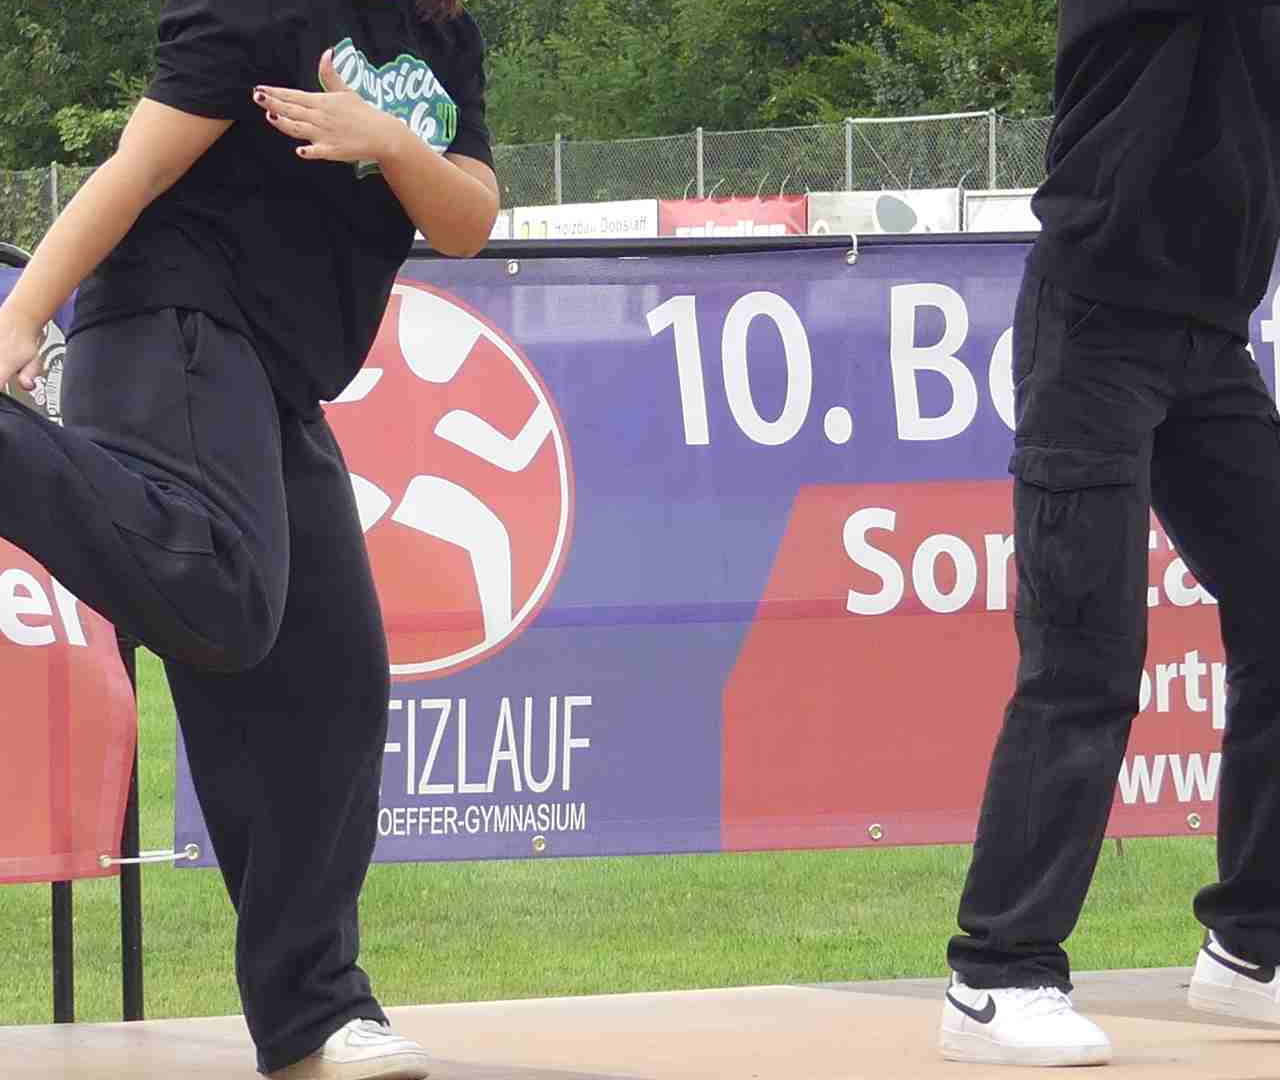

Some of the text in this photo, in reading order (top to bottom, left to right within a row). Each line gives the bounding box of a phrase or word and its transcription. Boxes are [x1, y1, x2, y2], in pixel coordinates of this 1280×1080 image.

[646, 291, 854, 448] 10.
[384, 696, 592, 795] IZLAUF
[377, 802, 586, 837] OEFFER-GYMNASIUM
